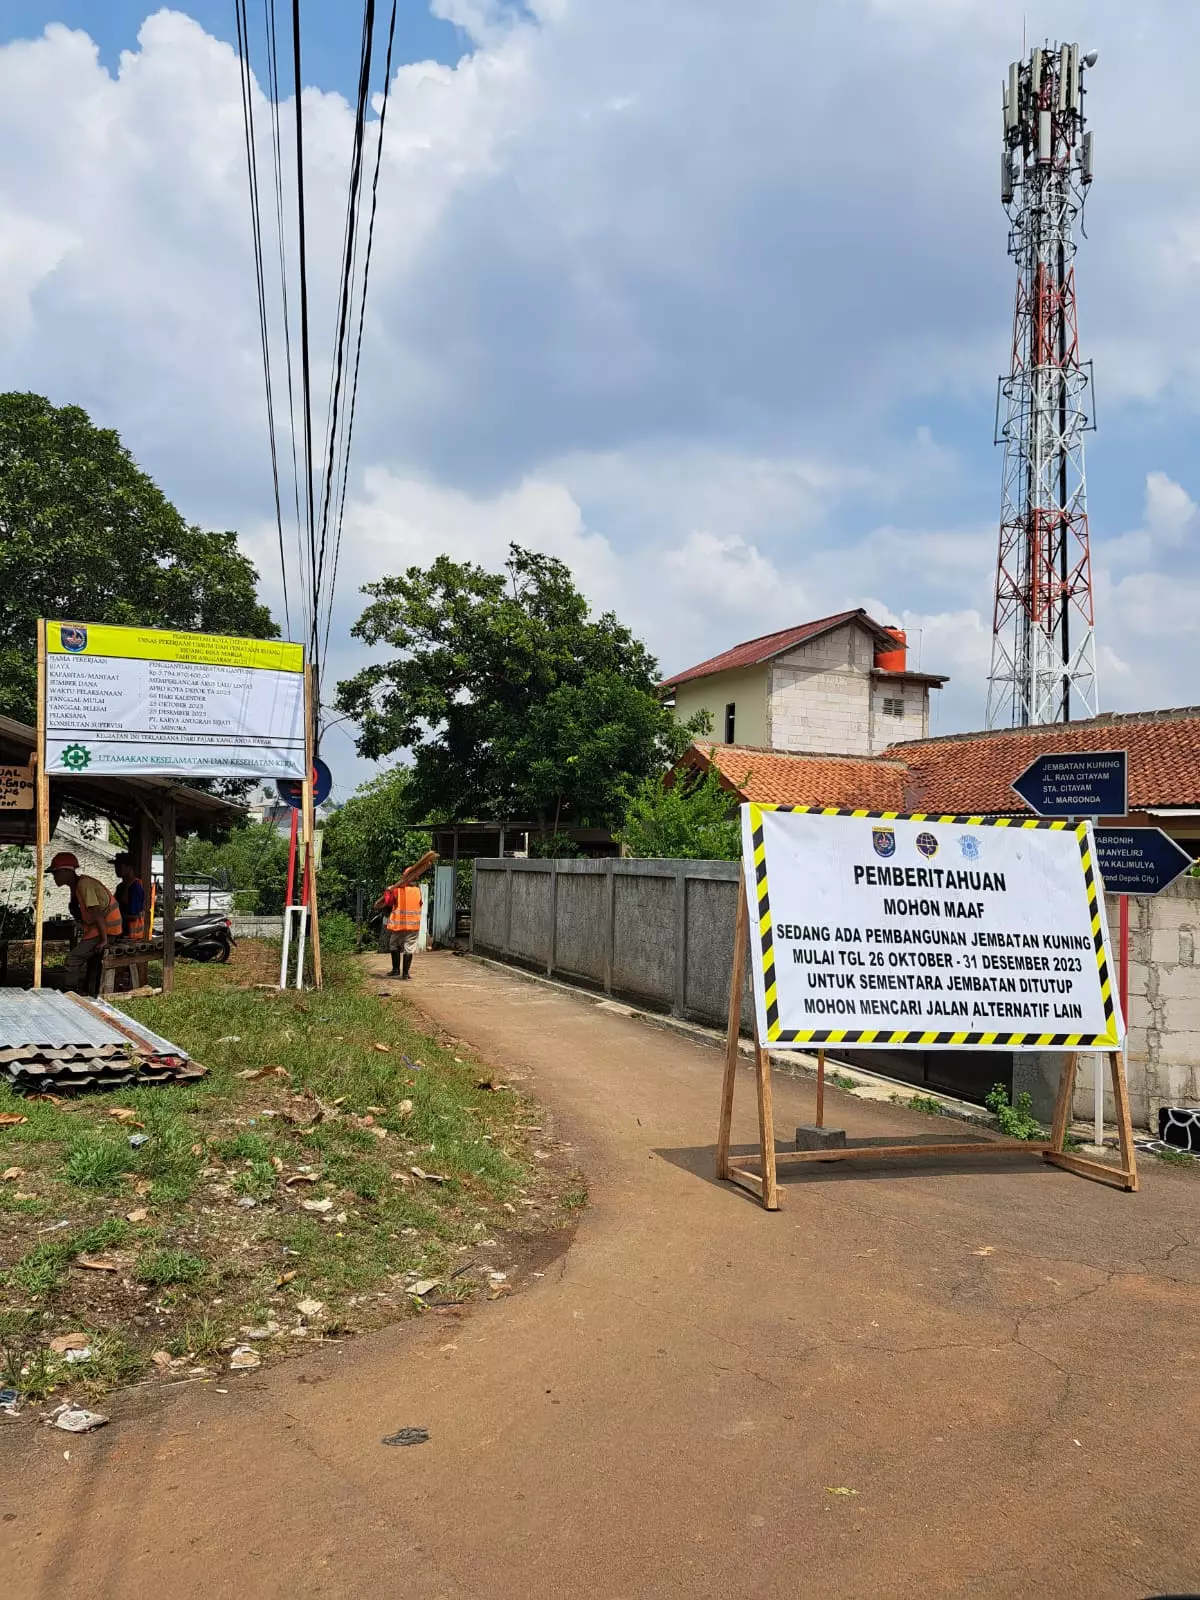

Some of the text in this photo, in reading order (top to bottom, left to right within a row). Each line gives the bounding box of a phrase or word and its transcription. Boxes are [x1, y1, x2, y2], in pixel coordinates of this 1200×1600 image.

[159, 638, 192, 647] PEKERJAAN
[72, 657, 108, 665] PEKERJAAN
[78, 681, 98, 689] DANA
[76, 688, 123, 697] PELAKSANAAN
[49, 720, 90, 728] KONSULTAN
[98, 755, 149, 763] UTAMAKAN
[150, 756, 210, 765] KESELAMATAN
[230, 759, 275, 767] KESEHATAN
[275, 761, 297, 769] KERJA
[1043, 760, 1120, 771] JEMBATAN KUNING
[1076, 772, 1110, 780] CITAYAM
[1043, 784, 1092, 793] STA. CITAYAM
[1043, 795, 1101, 804] JL. MARGONDA
[1111, 860, 1155, 869] KALIMULYA
[853, 865, 1007, 892] PEMBERITAHUAN
[1119, 874, 1140, 884] Depok
[883, 898, 985, 919] MOHON MAAF
[776, 924, 1092, 951] SEDANG ADA PEMBANGUNAN JEMBATAN KUNING
[792, 949, 835, 966] MULAI
[838, 950, 866, 967] TGL
[868, 951, 885, 968] 26
[888, 952, 954, 968] OKTOBER
[962, 954, 978, 969] 31
[982, 955, 1050, 972] DESEMBER
[1053, 957, 1082, 972] 2023
[807, 972, 1073, 994] UNTUK SEMENTARA JEMBATAN DITUTUP
[803, 998, 1083, 1019] MOHON MENCARI JALAN ALTERNATIF LAIN
